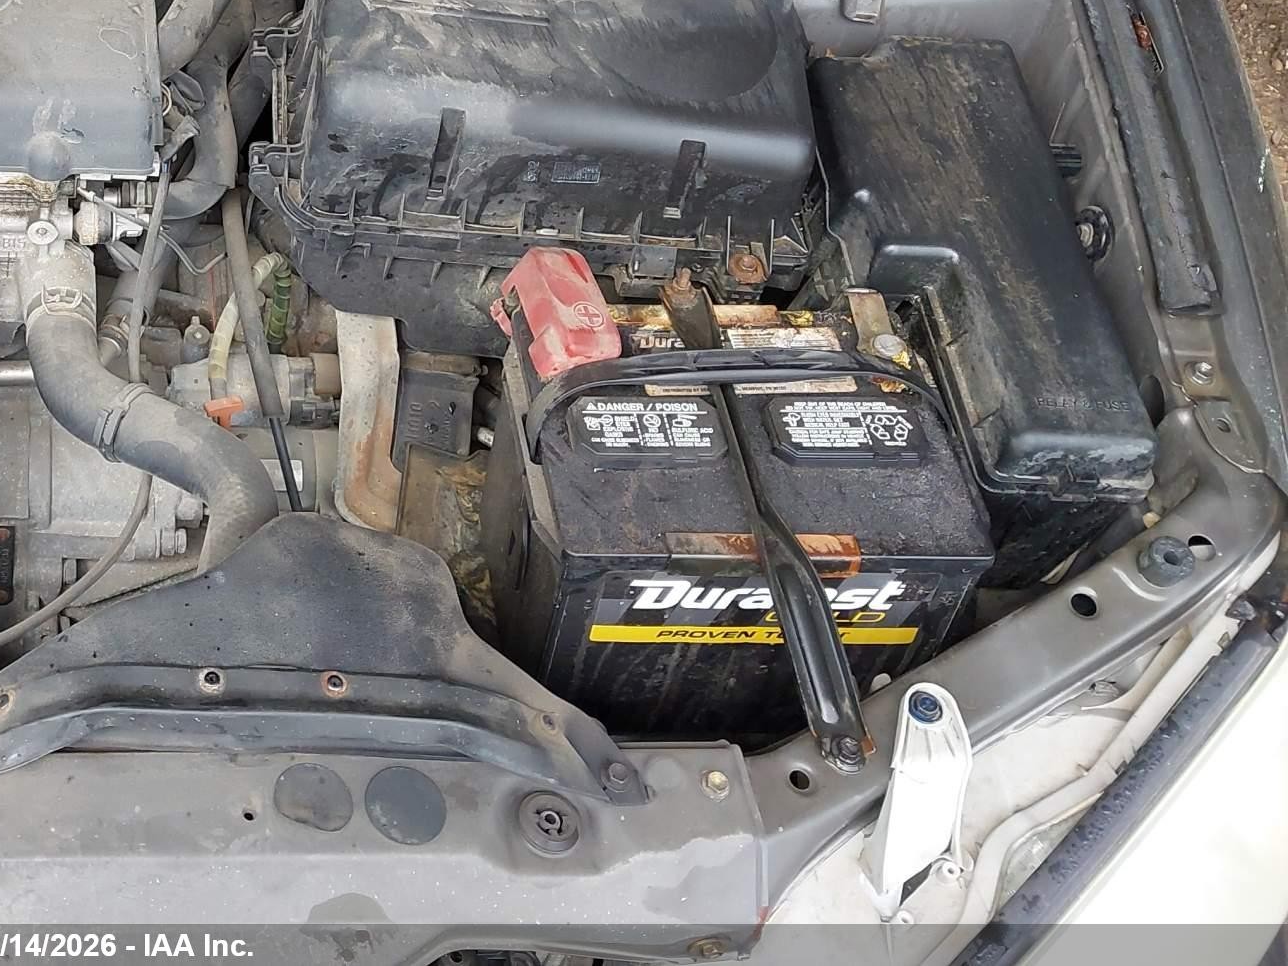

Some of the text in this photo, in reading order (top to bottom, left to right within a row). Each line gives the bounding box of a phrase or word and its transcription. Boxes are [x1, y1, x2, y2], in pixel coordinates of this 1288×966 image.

[639, 333, 685, 348] Dura
[597, 402, 698, 412] DANGER / POISON
[1095, 400, 1131, 412] FUSE
[629, 580, 905, 610] Durast
[656, 630, 754, 639] PROVEN
